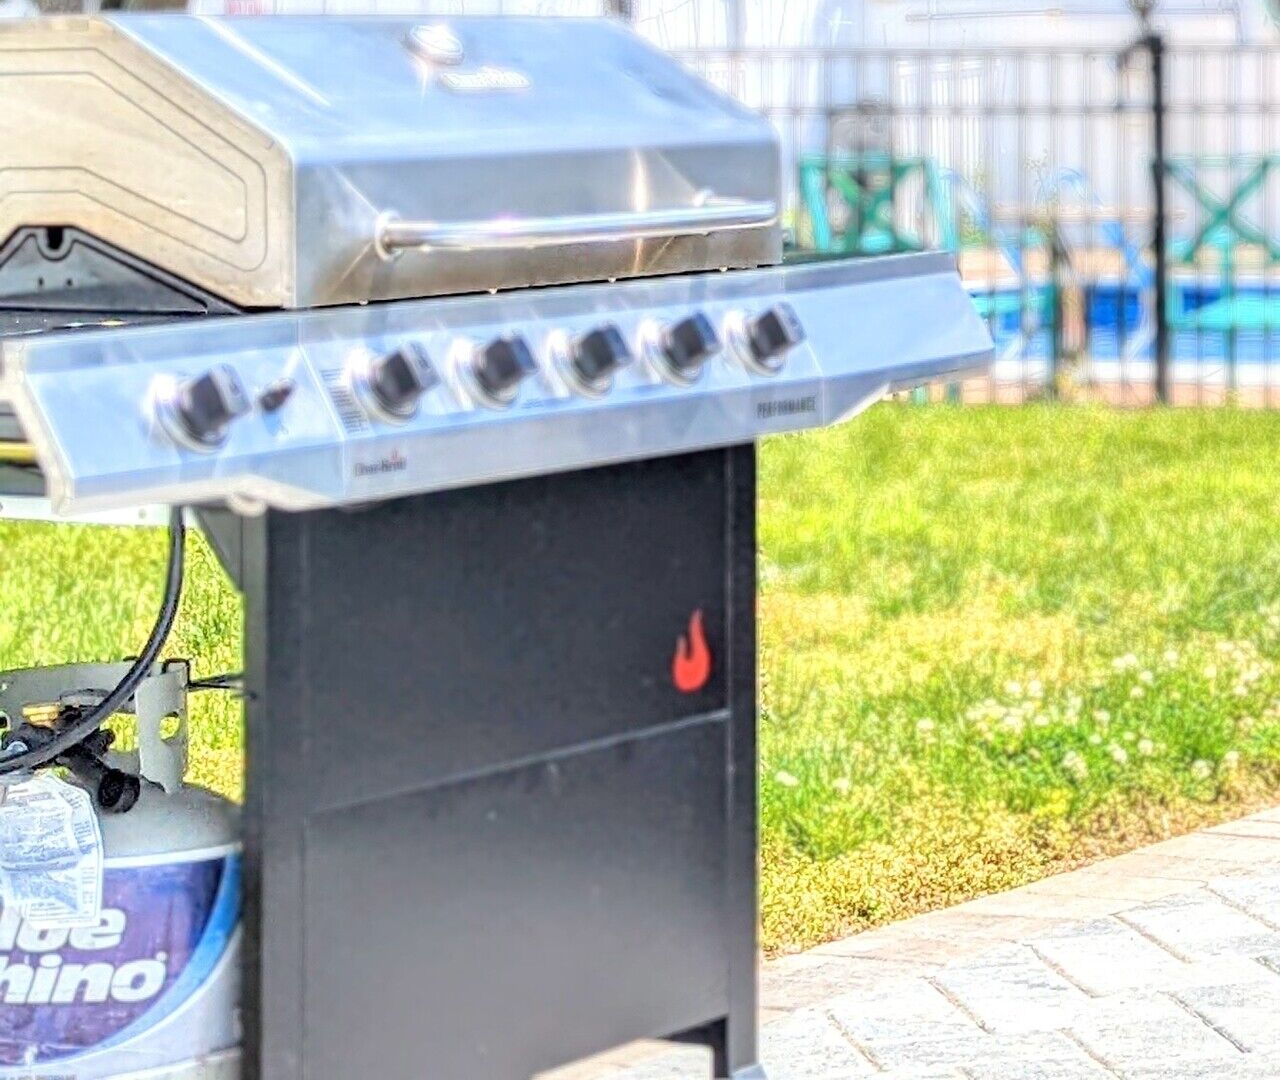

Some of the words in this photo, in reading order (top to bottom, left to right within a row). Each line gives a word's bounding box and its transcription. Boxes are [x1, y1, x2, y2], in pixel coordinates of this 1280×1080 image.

[757, 396, 816, 418] PERFORMANCE
[0, 896, 127, 951] lue
[0, 953, 167, 1003] hino
